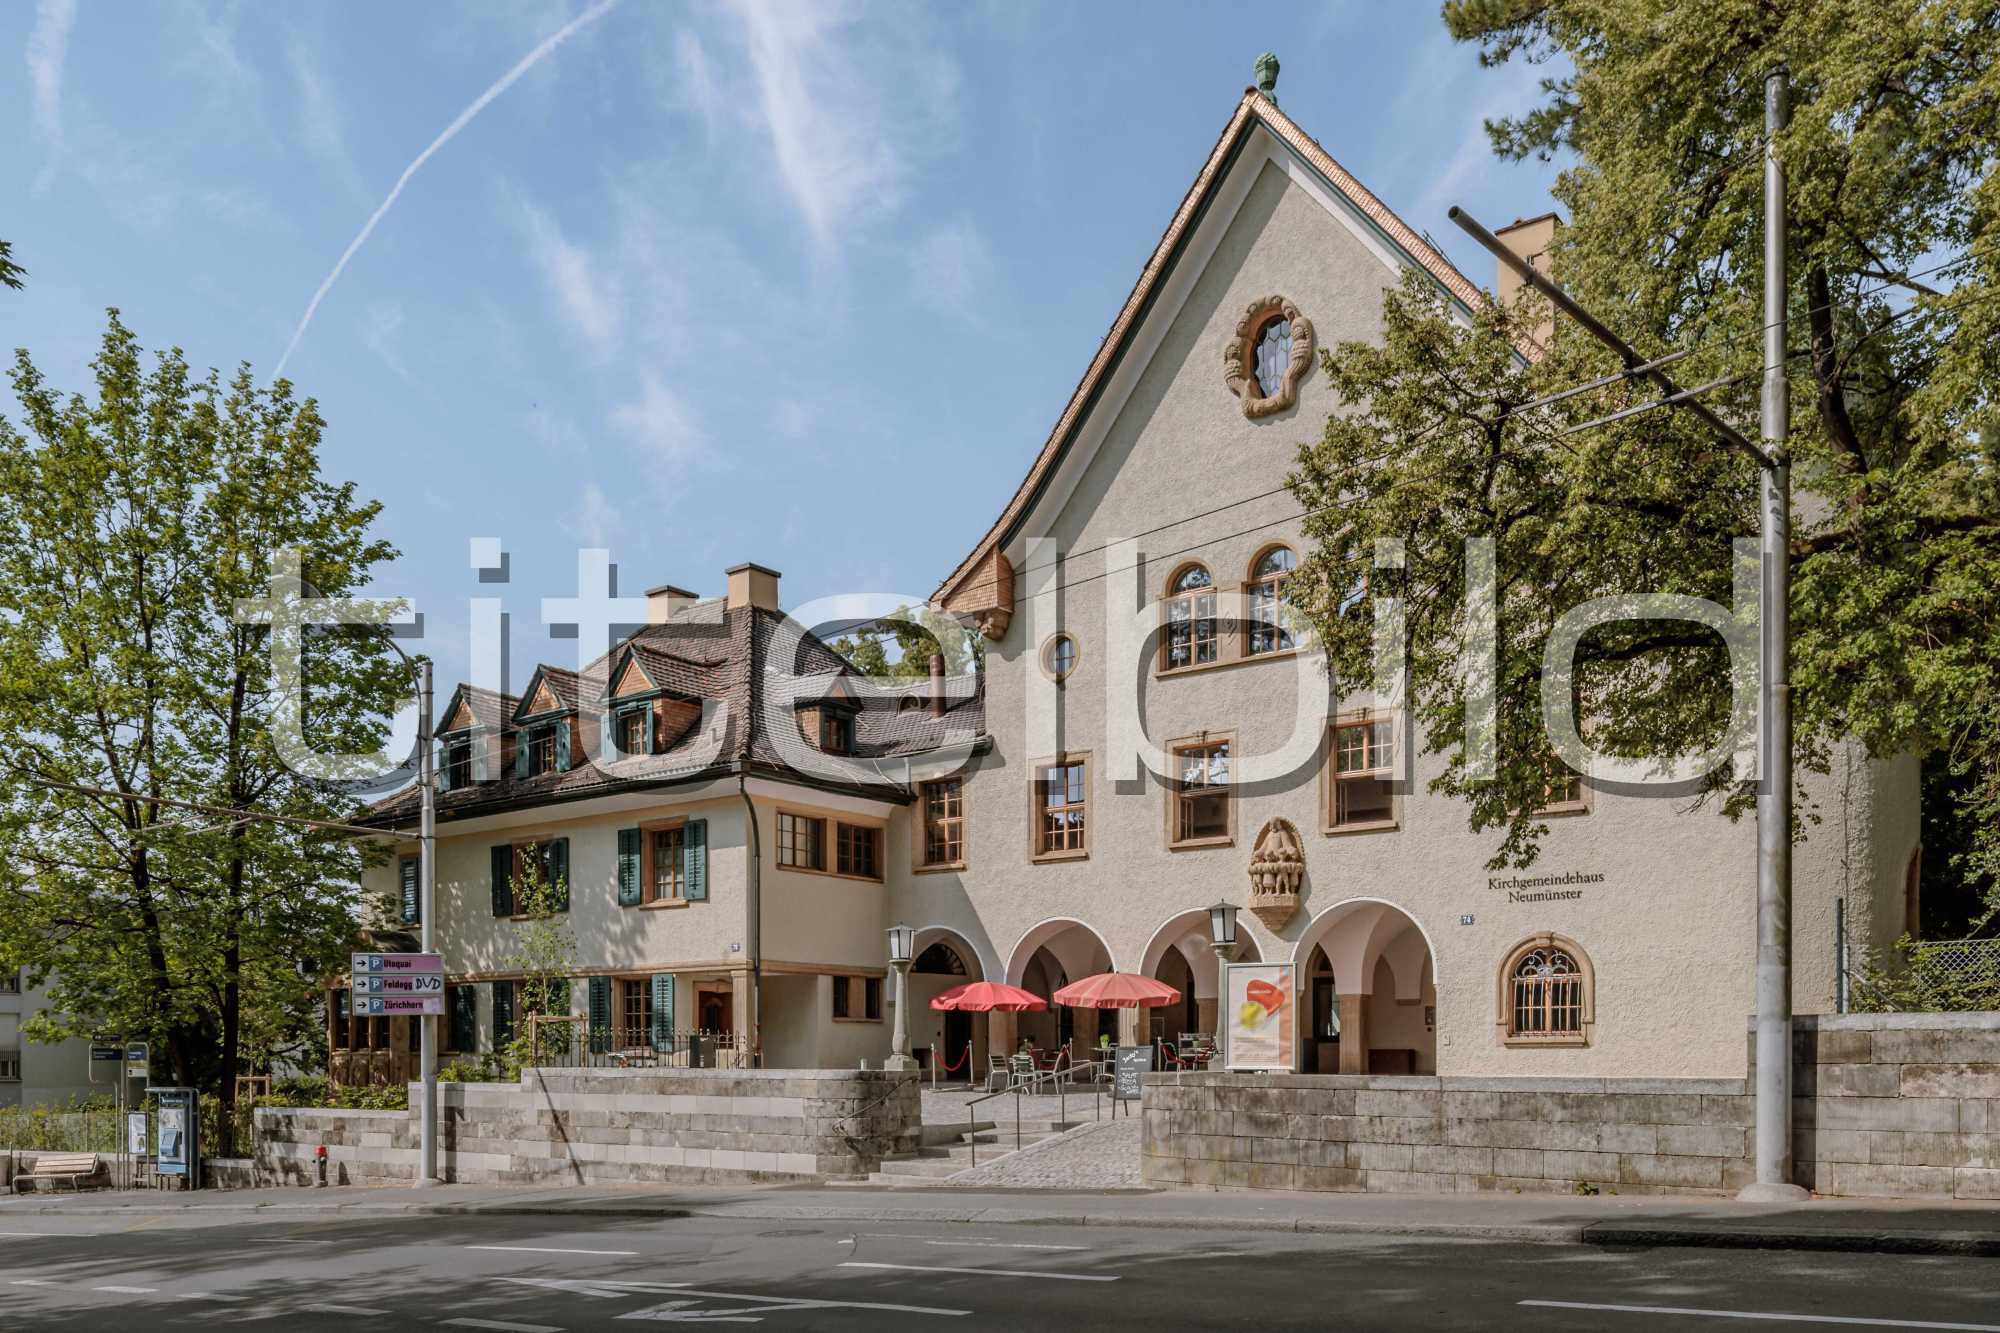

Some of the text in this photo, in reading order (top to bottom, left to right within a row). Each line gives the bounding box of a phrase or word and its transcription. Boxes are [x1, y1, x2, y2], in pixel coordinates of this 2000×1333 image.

[1488, 871, 1604, 889] Kirchgemeindehaus
[1508, 888, 1583, 903] Neumünster
[384, 960, 411, 970] Utoquai
[384, 980, 412, 991] Feldegg
[415, 976, 441, 990] DVD
[384, 1000, 423, 1010] Zürichhorn
